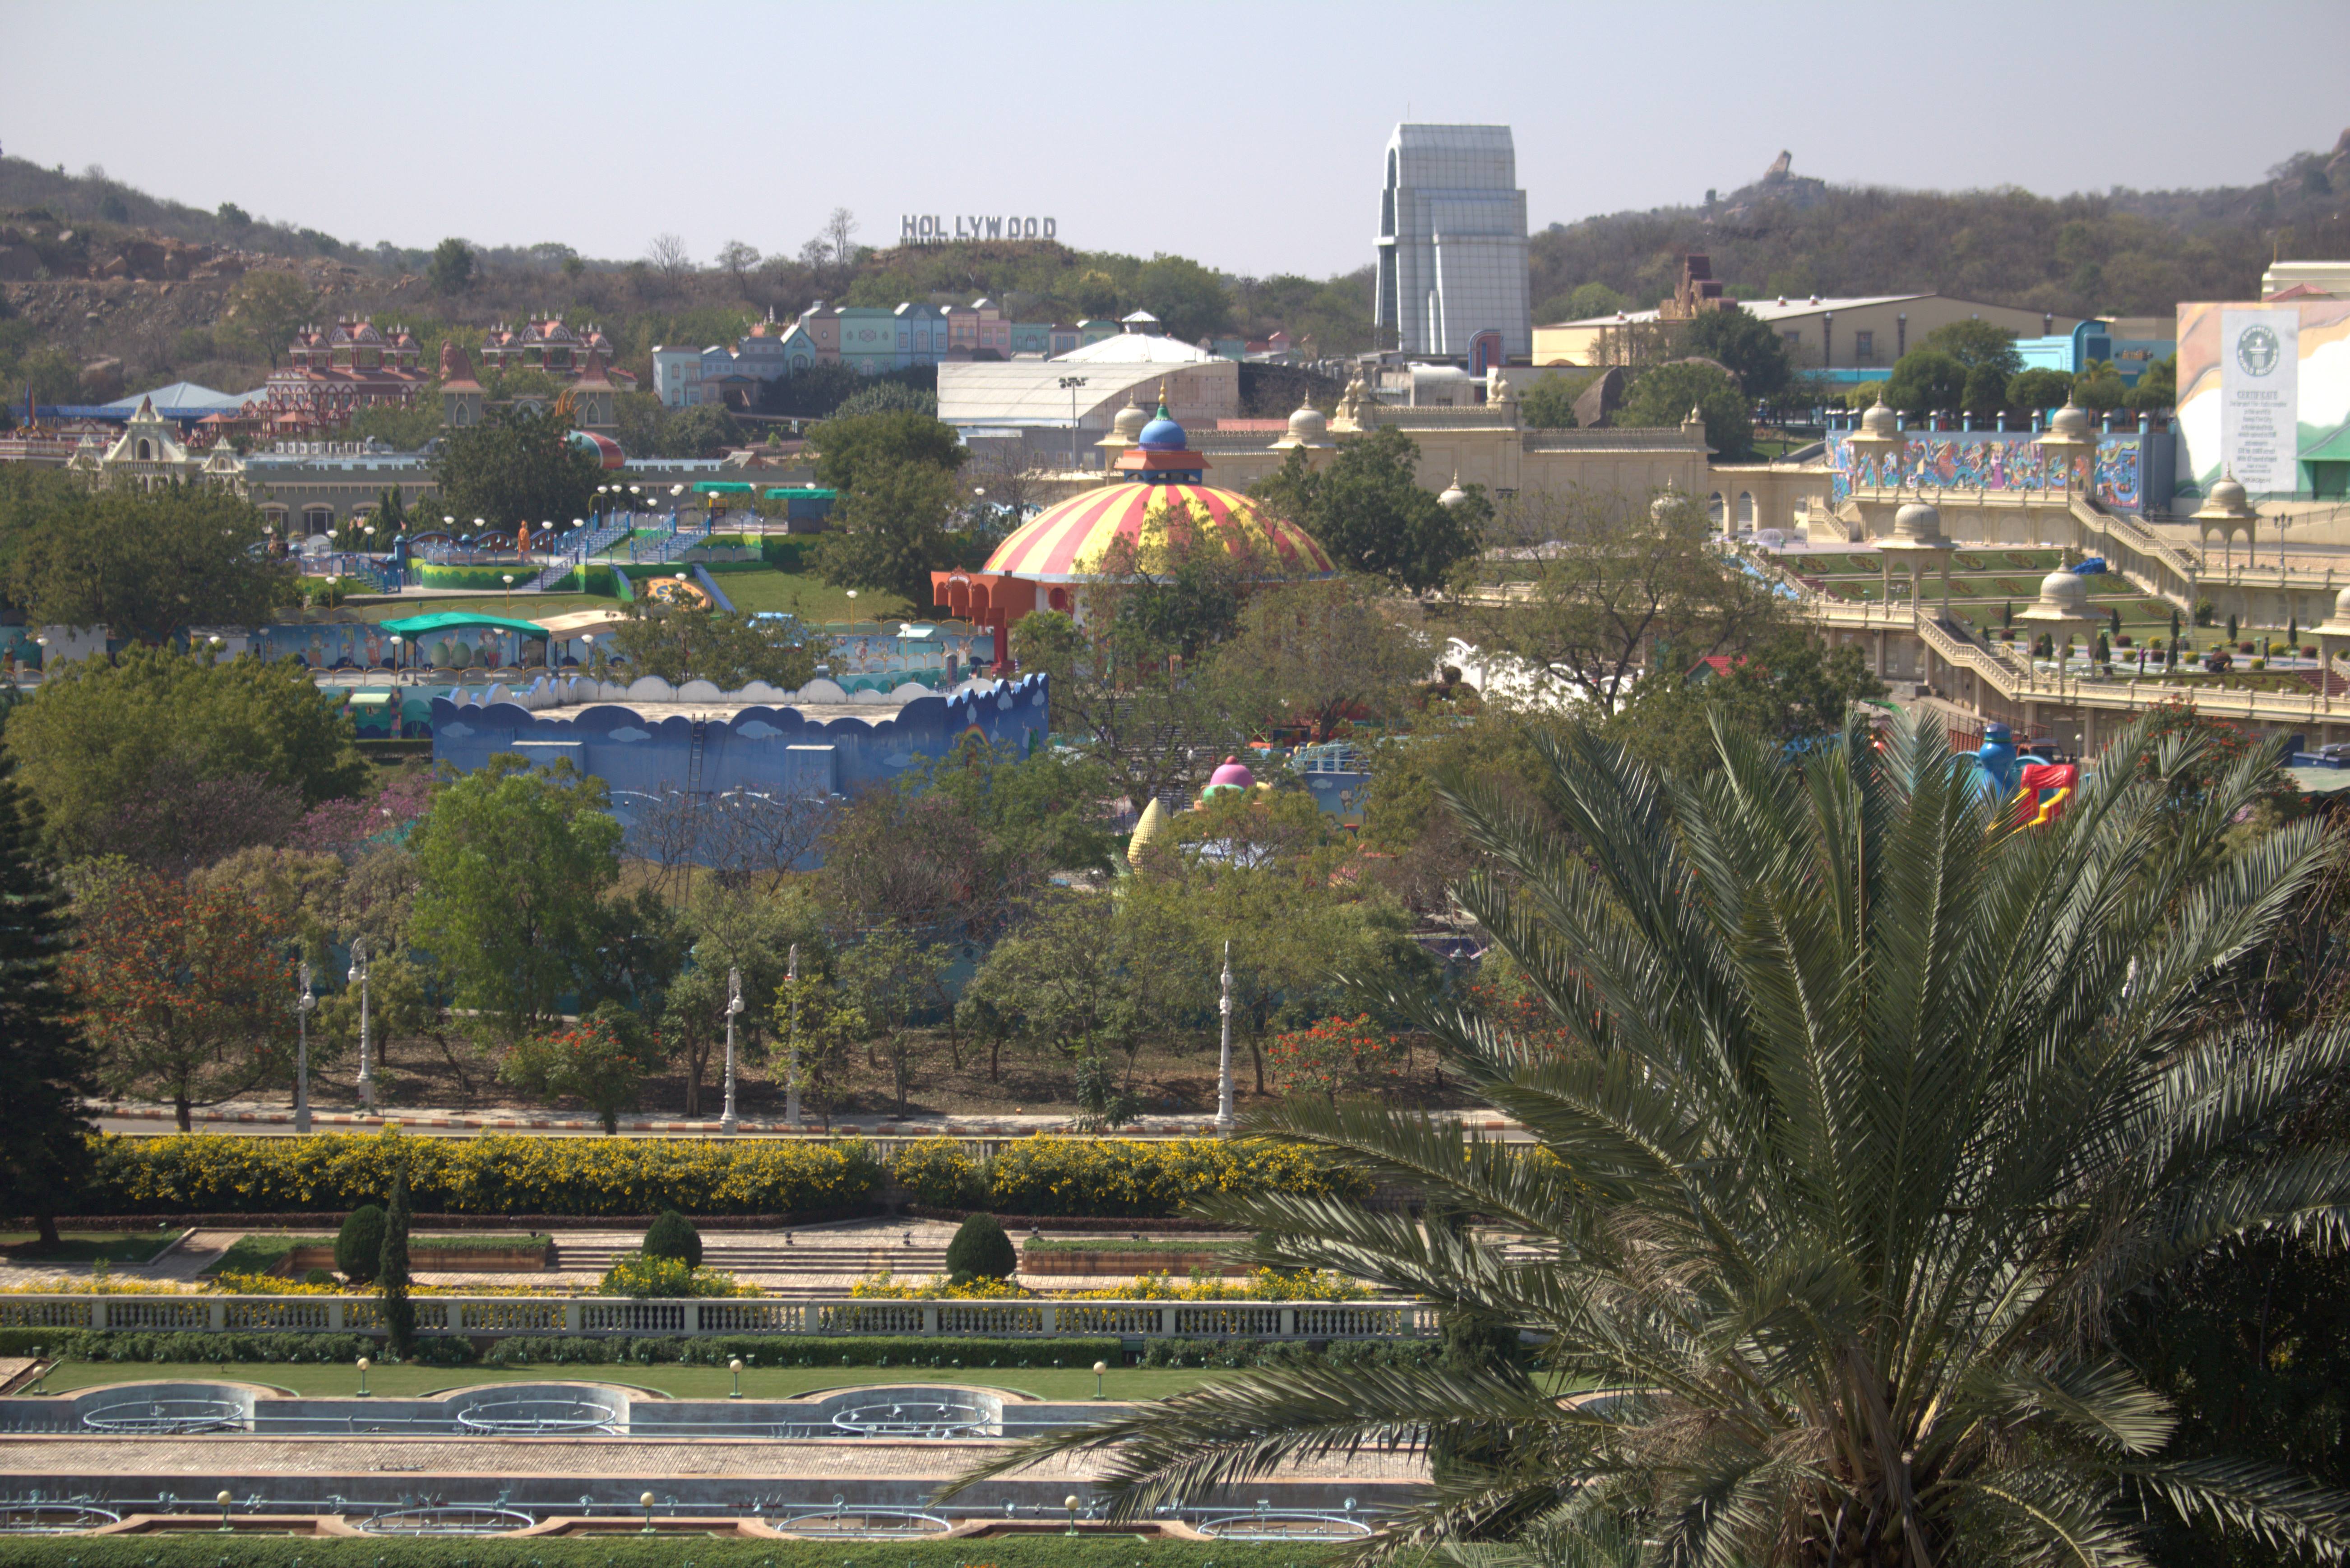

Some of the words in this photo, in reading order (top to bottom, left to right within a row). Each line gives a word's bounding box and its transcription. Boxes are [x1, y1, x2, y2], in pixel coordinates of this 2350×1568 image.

[900, 214, 1056, 239] HOLLYWOOD
[2241, 326, 2272, 341] GUINNESS
[2238, 348, 2253, 374] WORLD
[2255, 348, 2277, 375] RECORDS
[2238, 391, 2278, 399] CERTIFICATE
